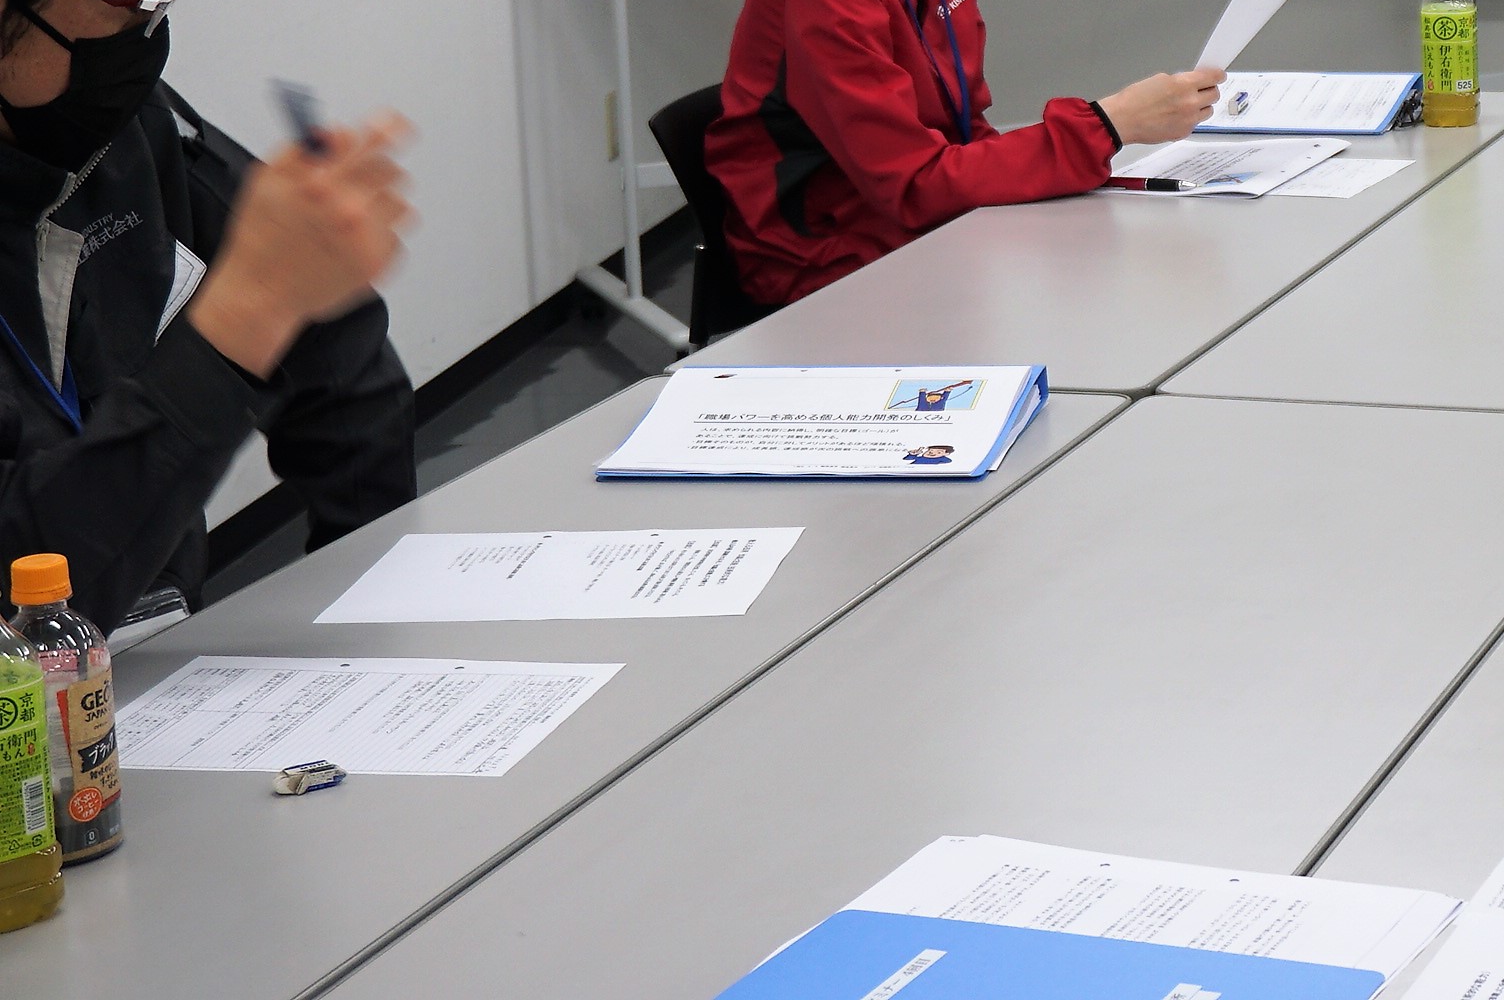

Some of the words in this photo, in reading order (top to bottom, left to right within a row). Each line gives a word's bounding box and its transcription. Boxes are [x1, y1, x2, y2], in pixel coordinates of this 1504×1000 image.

[1440, 45, 1452, 91] 伊右衛門
[1457, 81, 1472, 89] 525
[20, 692, 35, 723] 京都
